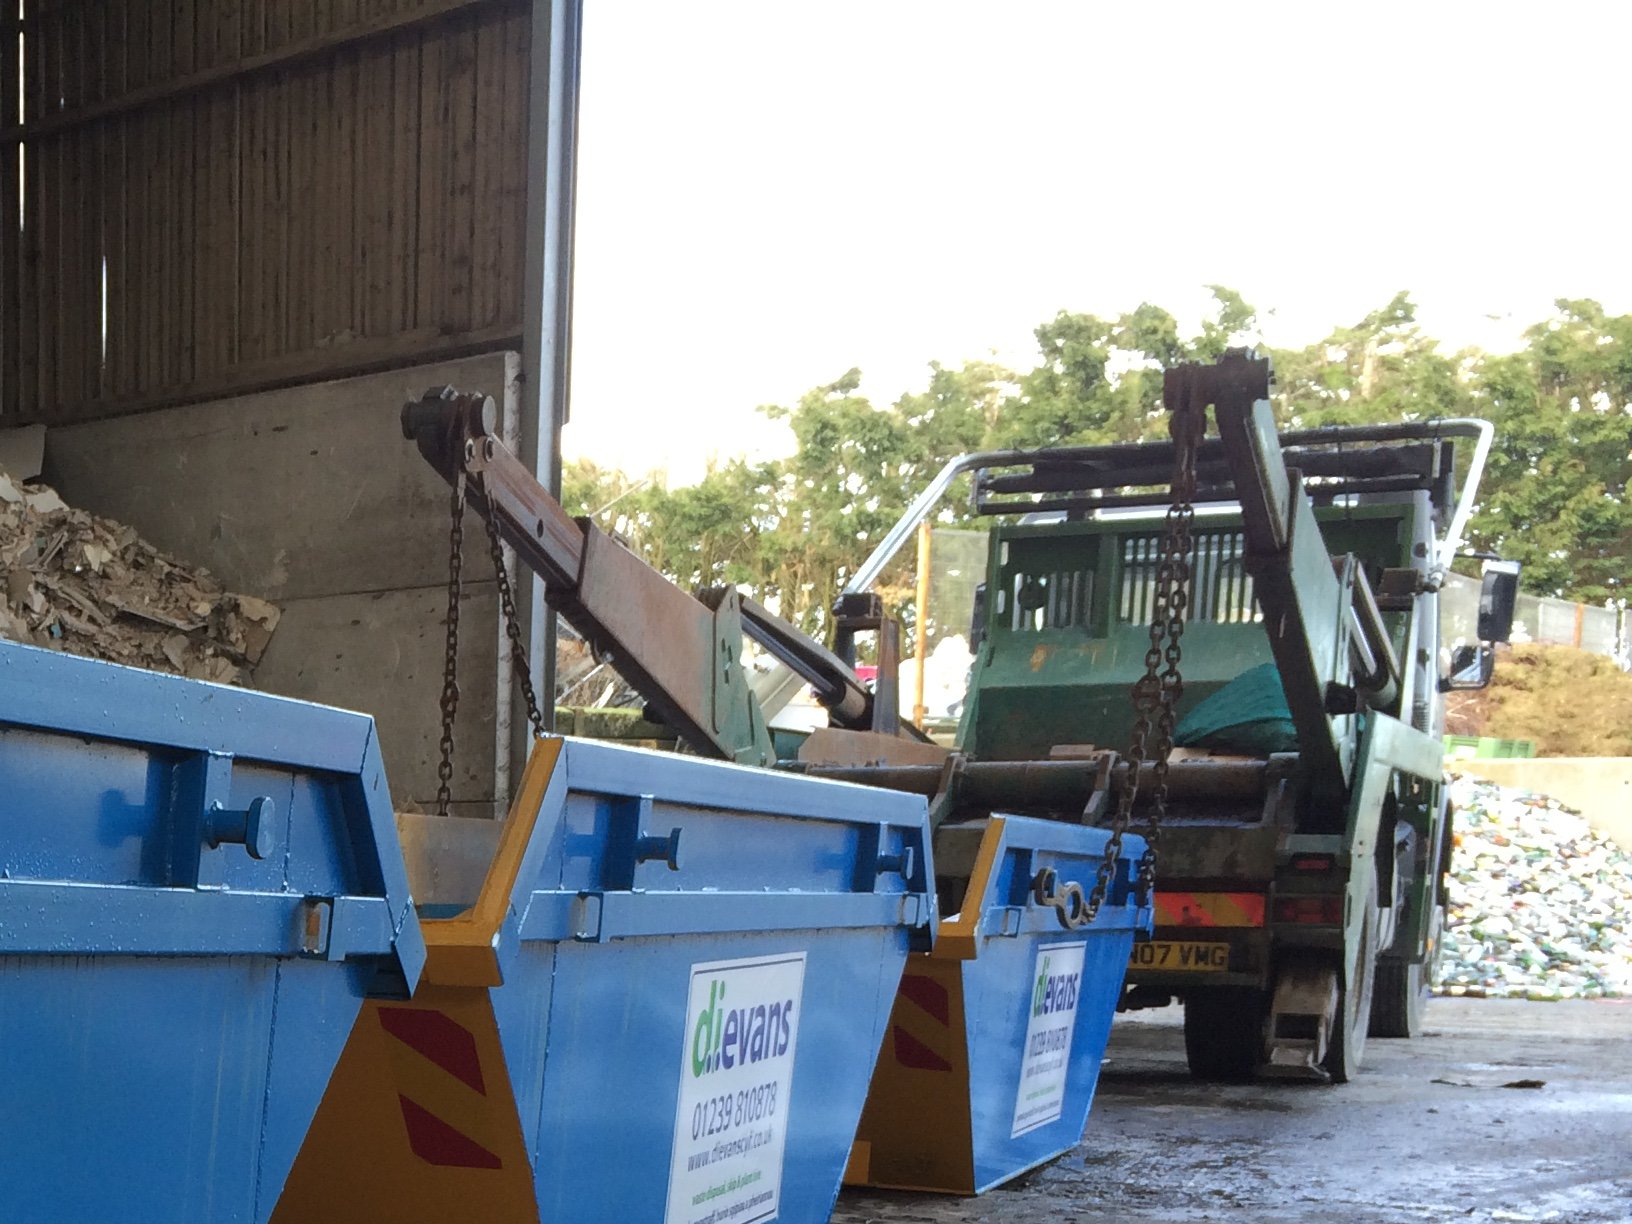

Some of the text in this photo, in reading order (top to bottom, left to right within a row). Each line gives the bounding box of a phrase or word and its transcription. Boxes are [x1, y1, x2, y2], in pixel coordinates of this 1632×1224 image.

[1179, 943, 1226, 967] VMG
[692, 1080, 777, 1141] 01239 810878
